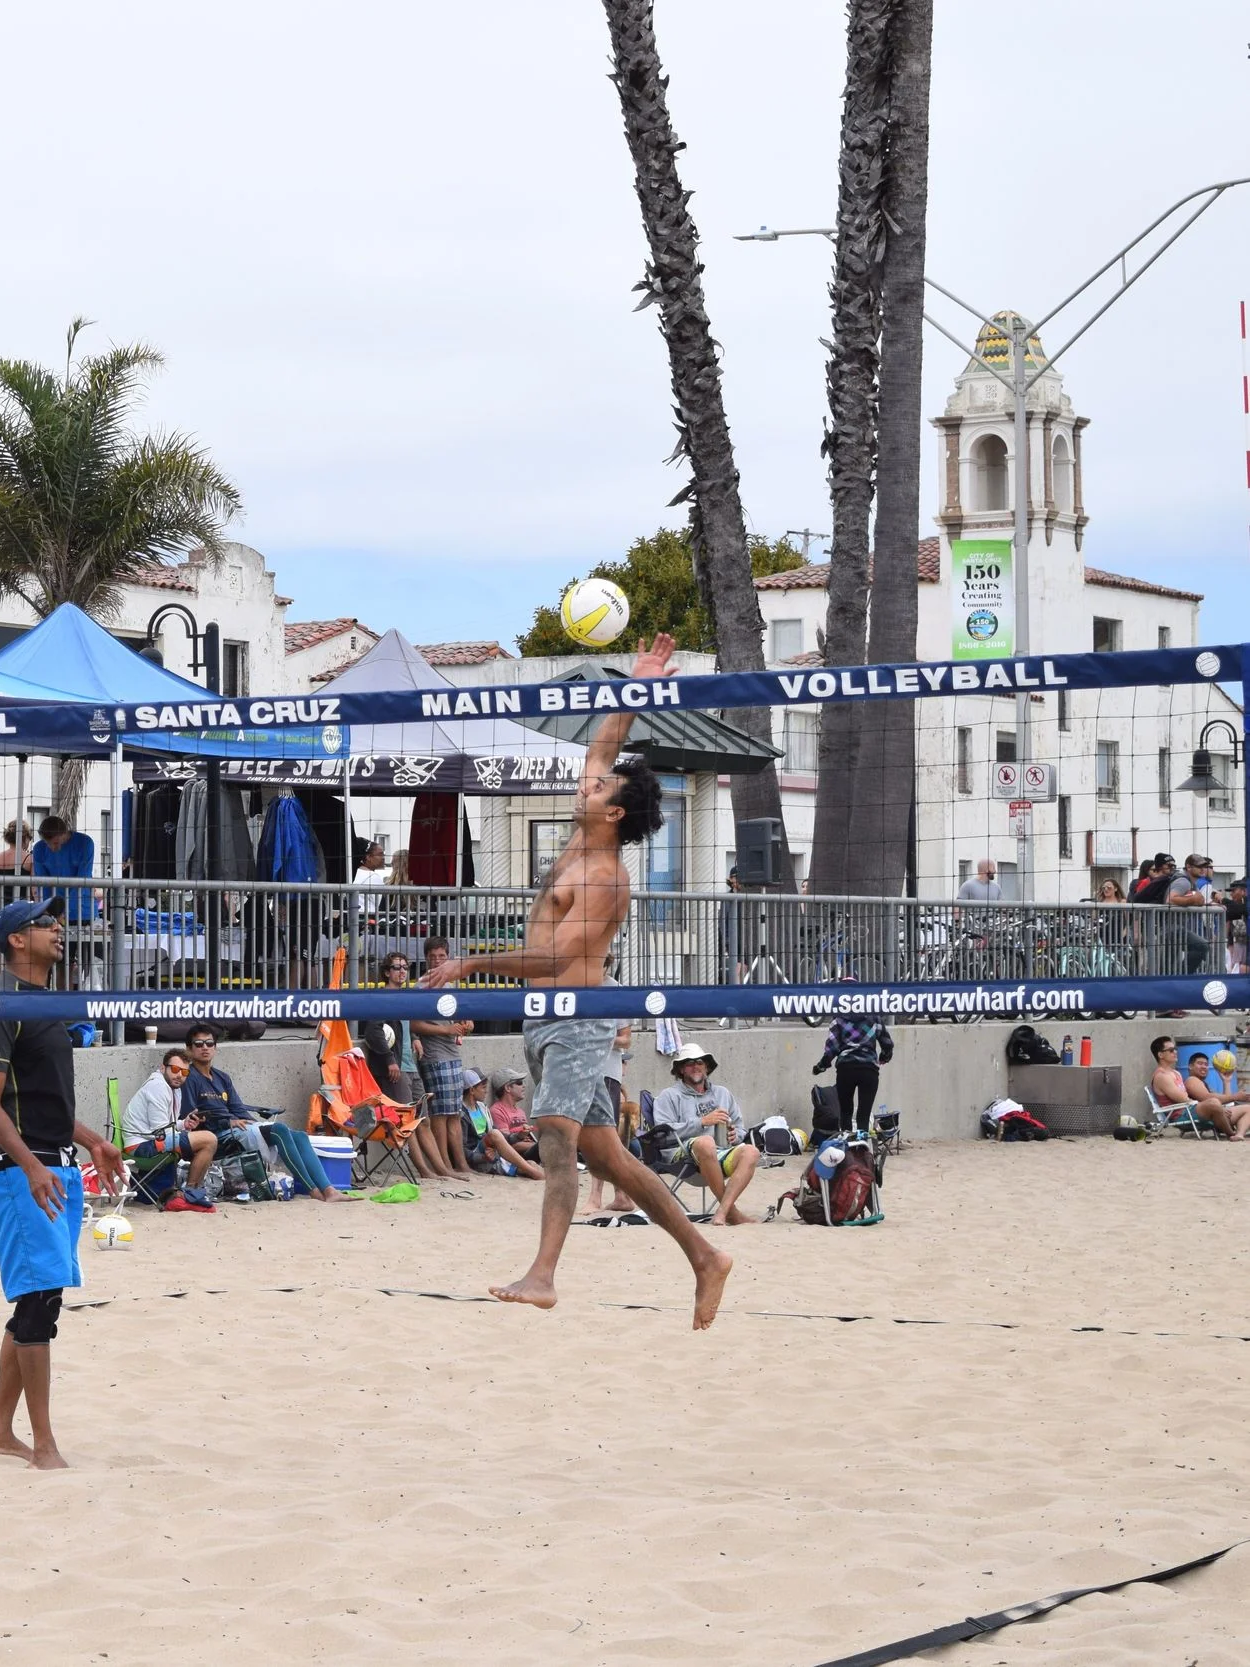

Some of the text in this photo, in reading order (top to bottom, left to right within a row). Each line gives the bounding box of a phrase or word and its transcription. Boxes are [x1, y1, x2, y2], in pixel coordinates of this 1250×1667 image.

[966, 564, 1000, 580] 150
[961, 591, 1002, 600] Creating
[963, 580, 999, 590] Years
[962, 601, 1002, 609] Community
[778, 661, 1067, 698] VOLLEYBALL
[422, 682, 680, 716] MAIN BEACH
[135, 702, 242, 728] SANTA
[250, 699, 340, 724] CRUZ
[510, 756, 553, 780] 2DEEP
[87, 995, 341, 1019] www.santacruzwharf.com
[773, 986, 1084, 1015] www.santacruzwharf.com
